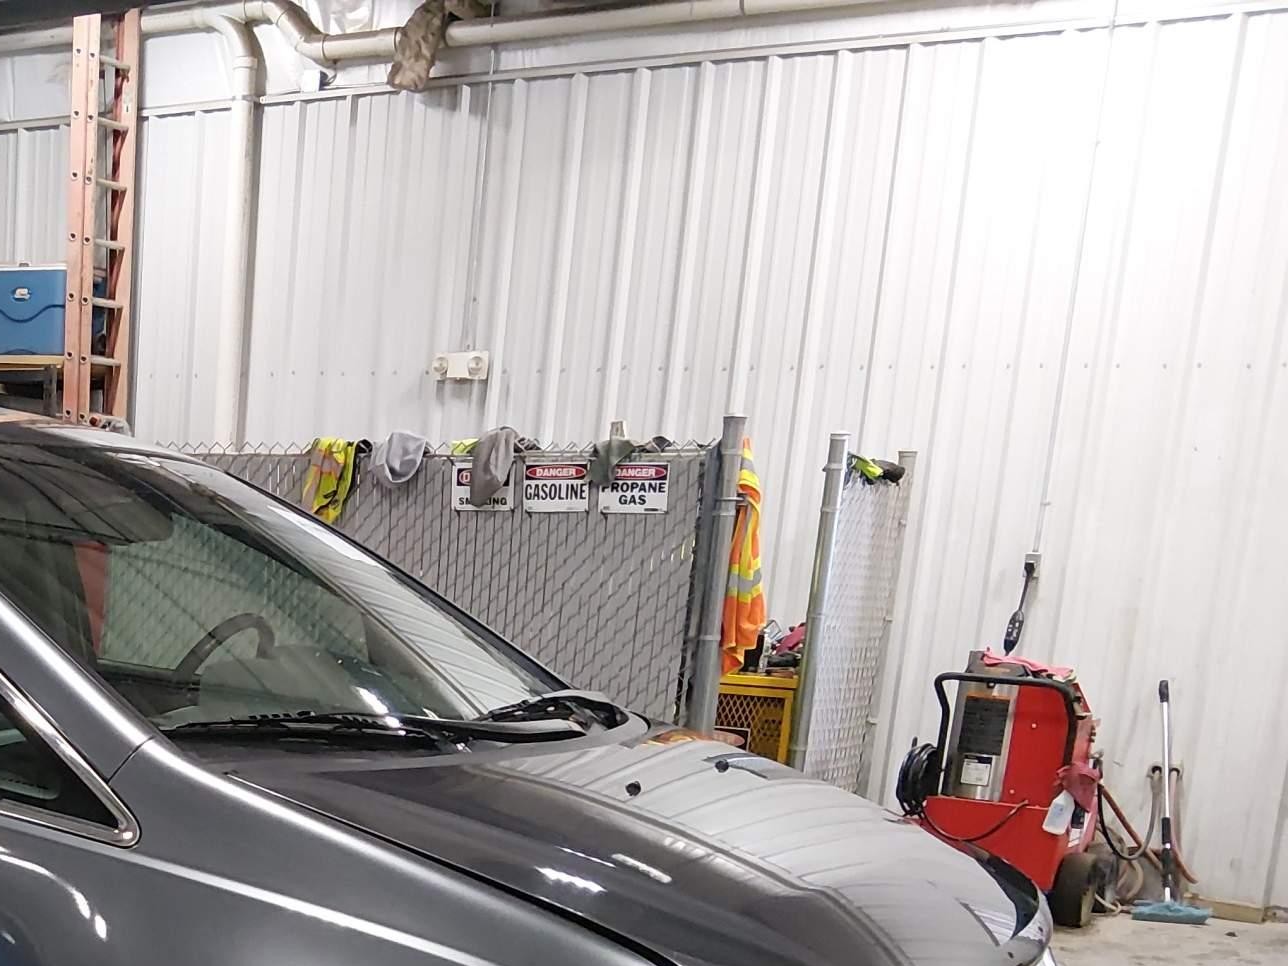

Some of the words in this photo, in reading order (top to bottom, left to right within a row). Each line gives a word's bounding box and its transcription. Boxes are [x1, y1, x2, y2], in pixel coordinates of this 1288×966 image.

[535, 467, 577, 477] DANGER
[524, 483, 587, 501] GASOLINE
[618, 494, 647, 506] GAS
